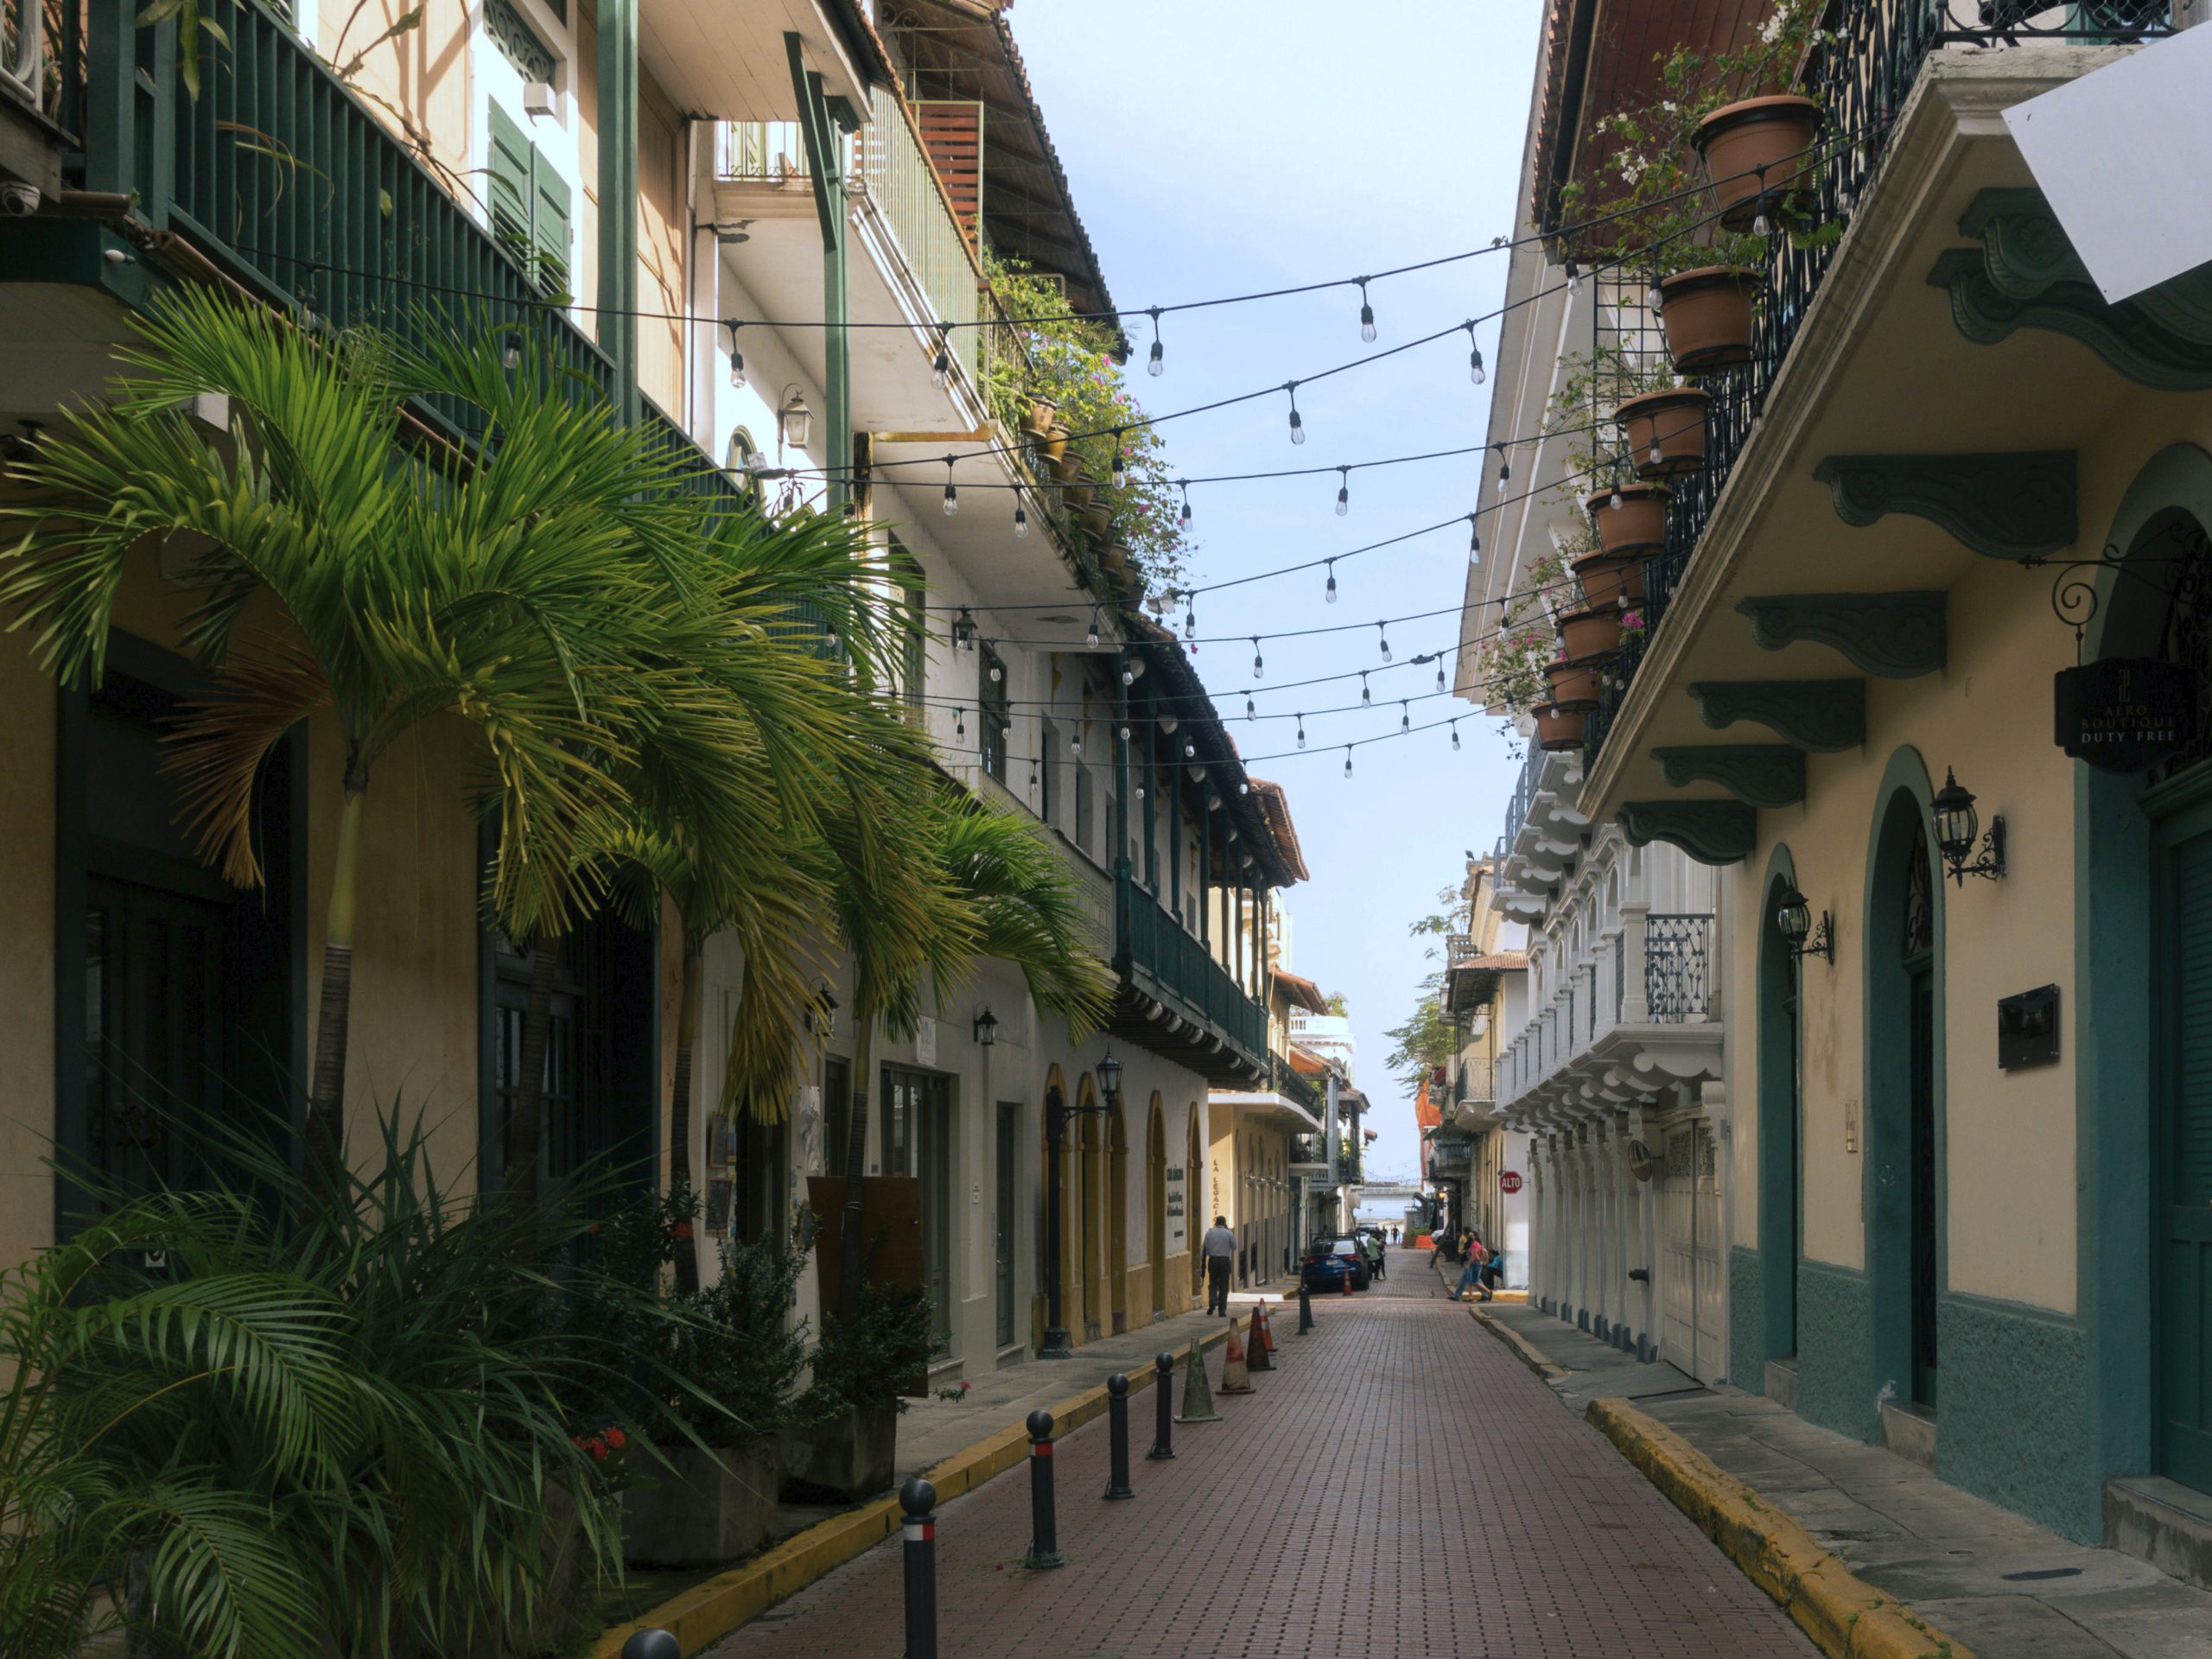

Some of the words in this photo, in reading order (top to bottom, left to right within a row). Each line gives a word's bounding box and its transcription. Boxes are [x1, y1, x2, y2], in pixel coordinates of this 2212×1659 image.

[2104, 705, 2148, 716] AERO
[2082, 716, 2175, 729] BOUTIQUE
[2082, 733, 2126, 743] DUTY
[2137, 731, 2175, 741] FREE
[1213, 1160, 1219, 1172] LA
[1502, 1177, 1521, 1188] ALTO
